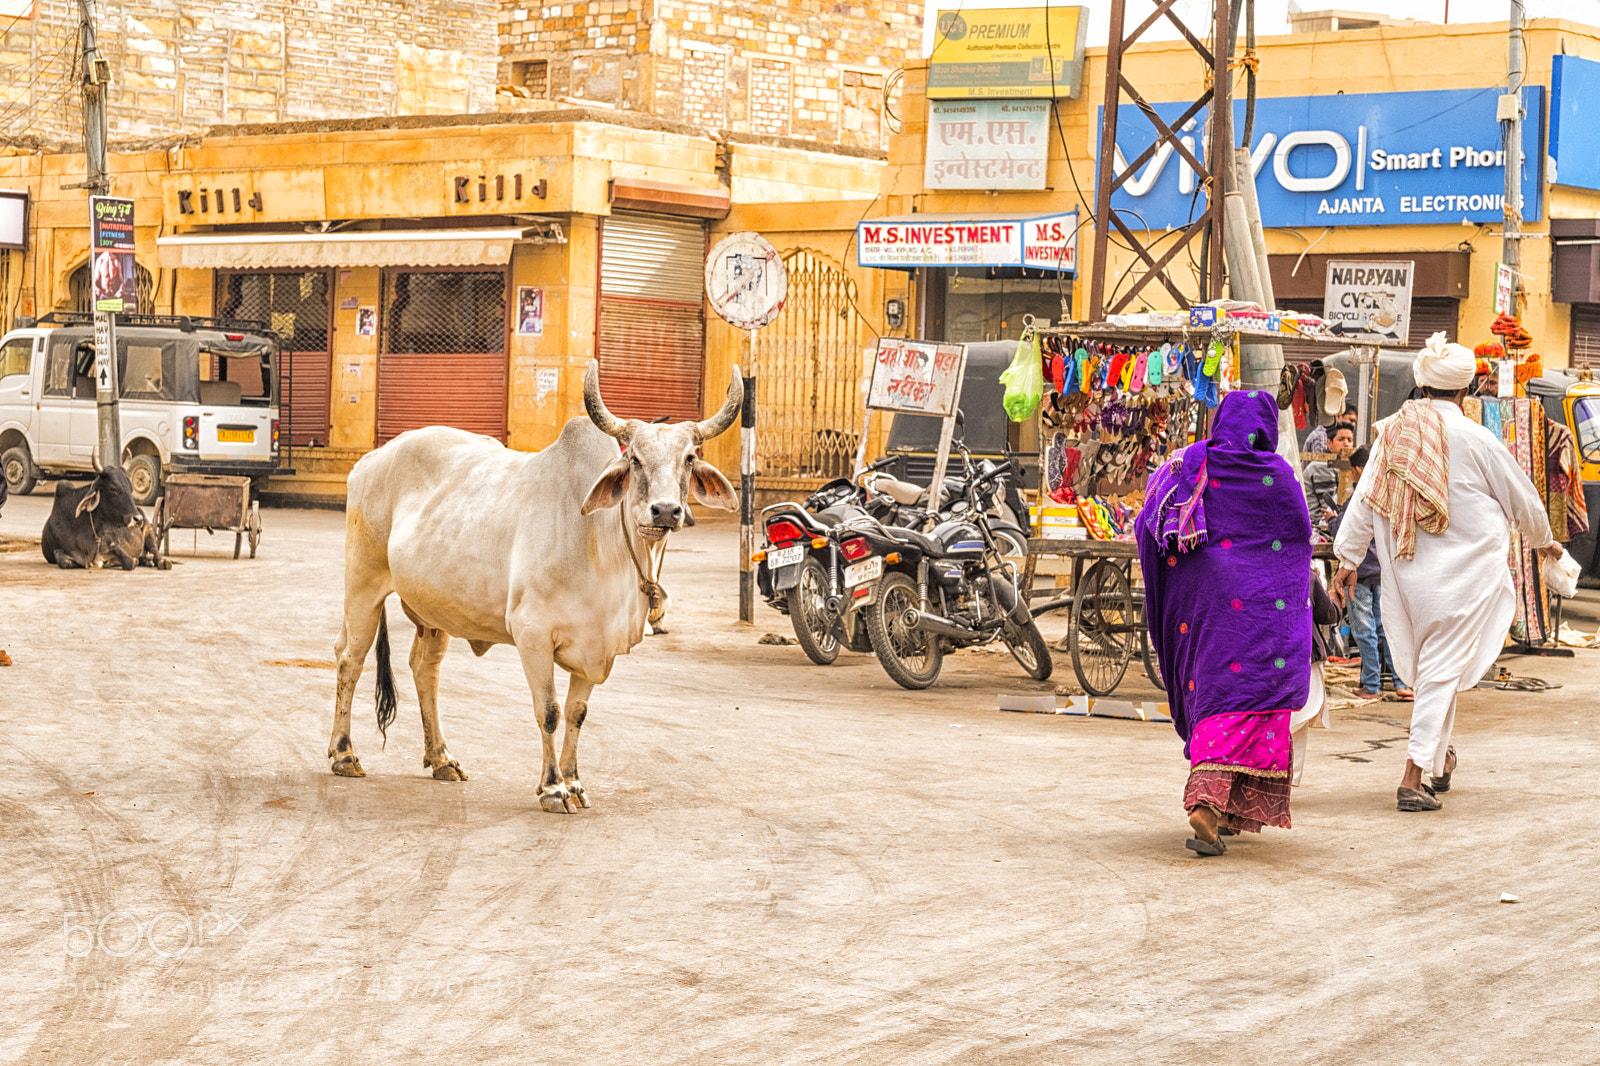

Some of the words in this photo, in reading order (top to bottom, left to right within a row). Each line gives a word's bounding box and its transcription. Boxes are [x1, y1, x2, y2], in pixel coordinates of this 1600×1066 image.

[969, 23, 1031, 39] PREMIUM
[1044, 58, 1061, 72] LC
[987, 87, 1033, 95] Investment
[1370, 147, 1442, 171] Smart
[1450, 146, 1526, 168] Phon
[1317, 197, 1385, 215] AJANTA
[101, 222, 133, 232] NUTRITION
[102, 231, 125, 239] FITNESS
[1035, 222, 1066, 242] M.S.
[1331, 268, 1407, 287] NARAYAN
